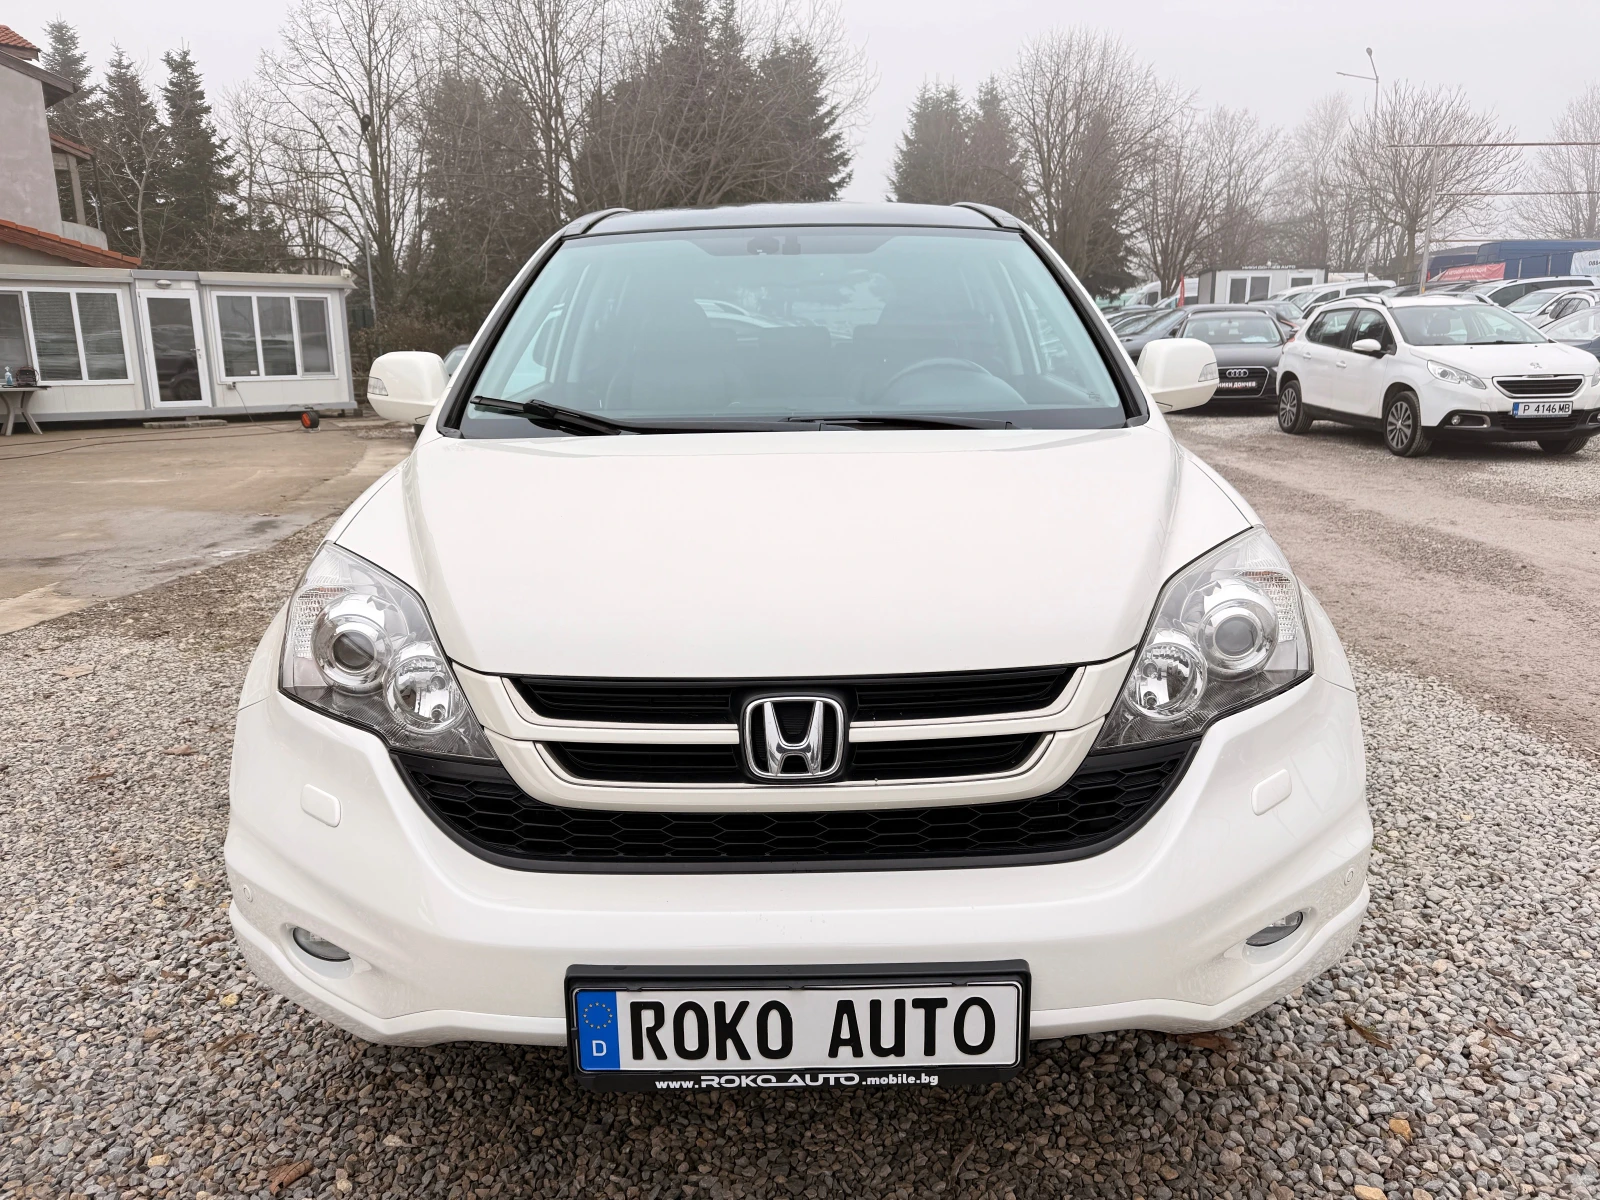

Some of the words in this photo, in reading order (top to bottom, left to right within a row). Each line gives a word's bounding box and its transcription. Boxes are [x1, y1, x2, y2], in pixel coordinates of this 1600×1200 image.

[1534, 403, 1557, 414] 4146
[629, 1000, 794, 1061] ROKO
[827, 996, 996, 1058] AUTO
[592, 1039, 607, 1057] D
